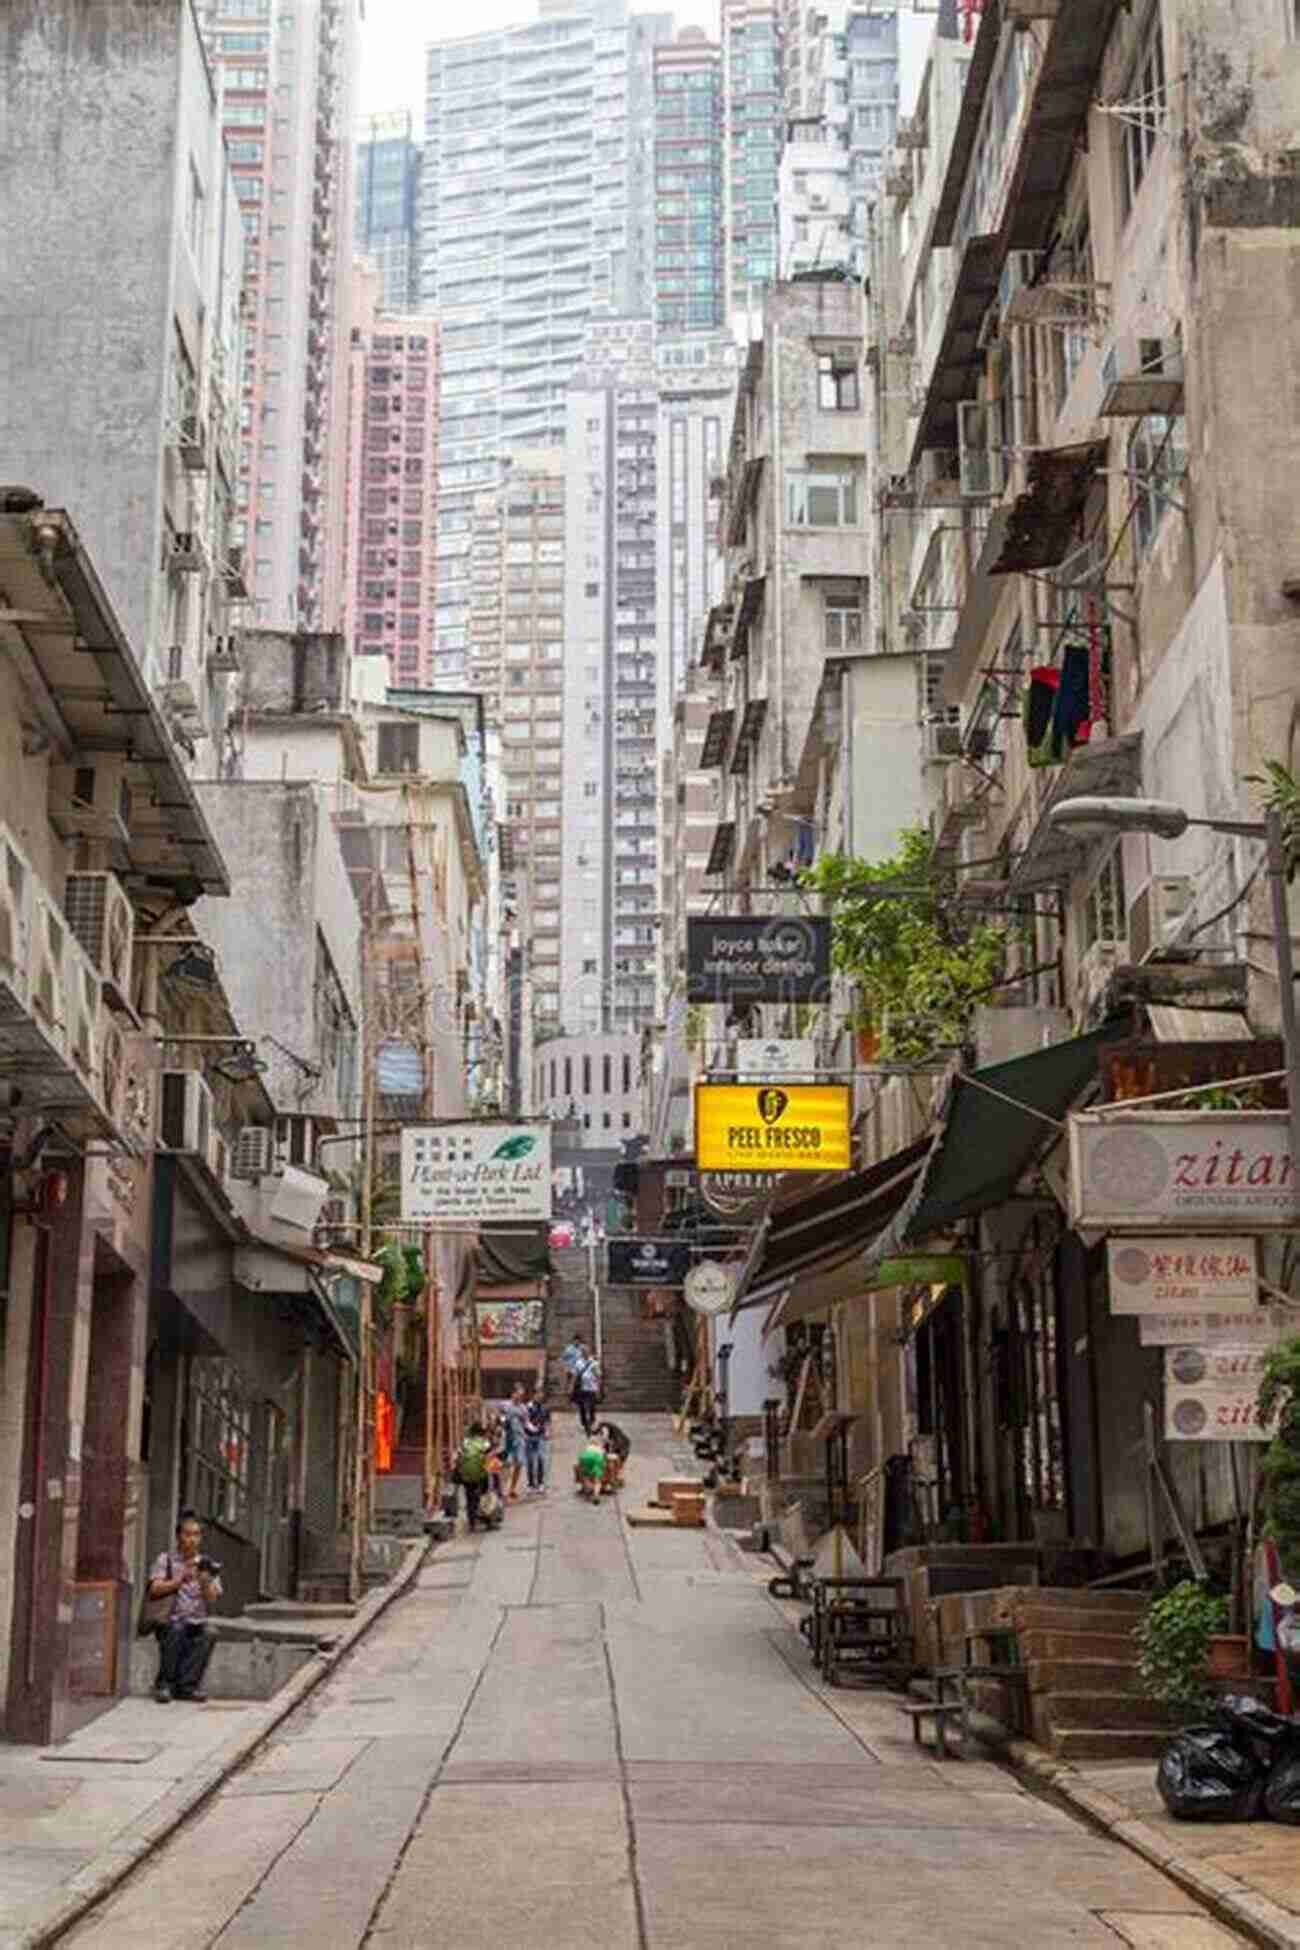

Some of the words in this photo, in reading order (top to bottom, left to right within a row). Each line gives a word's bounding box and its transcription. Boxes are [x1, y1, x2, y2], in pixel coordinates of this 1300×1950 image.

[711, 936, 754, 956] joyce
[728, 1127, 763, 1149] PEEL
[765, 1127, 821, 1149] FRESCO
